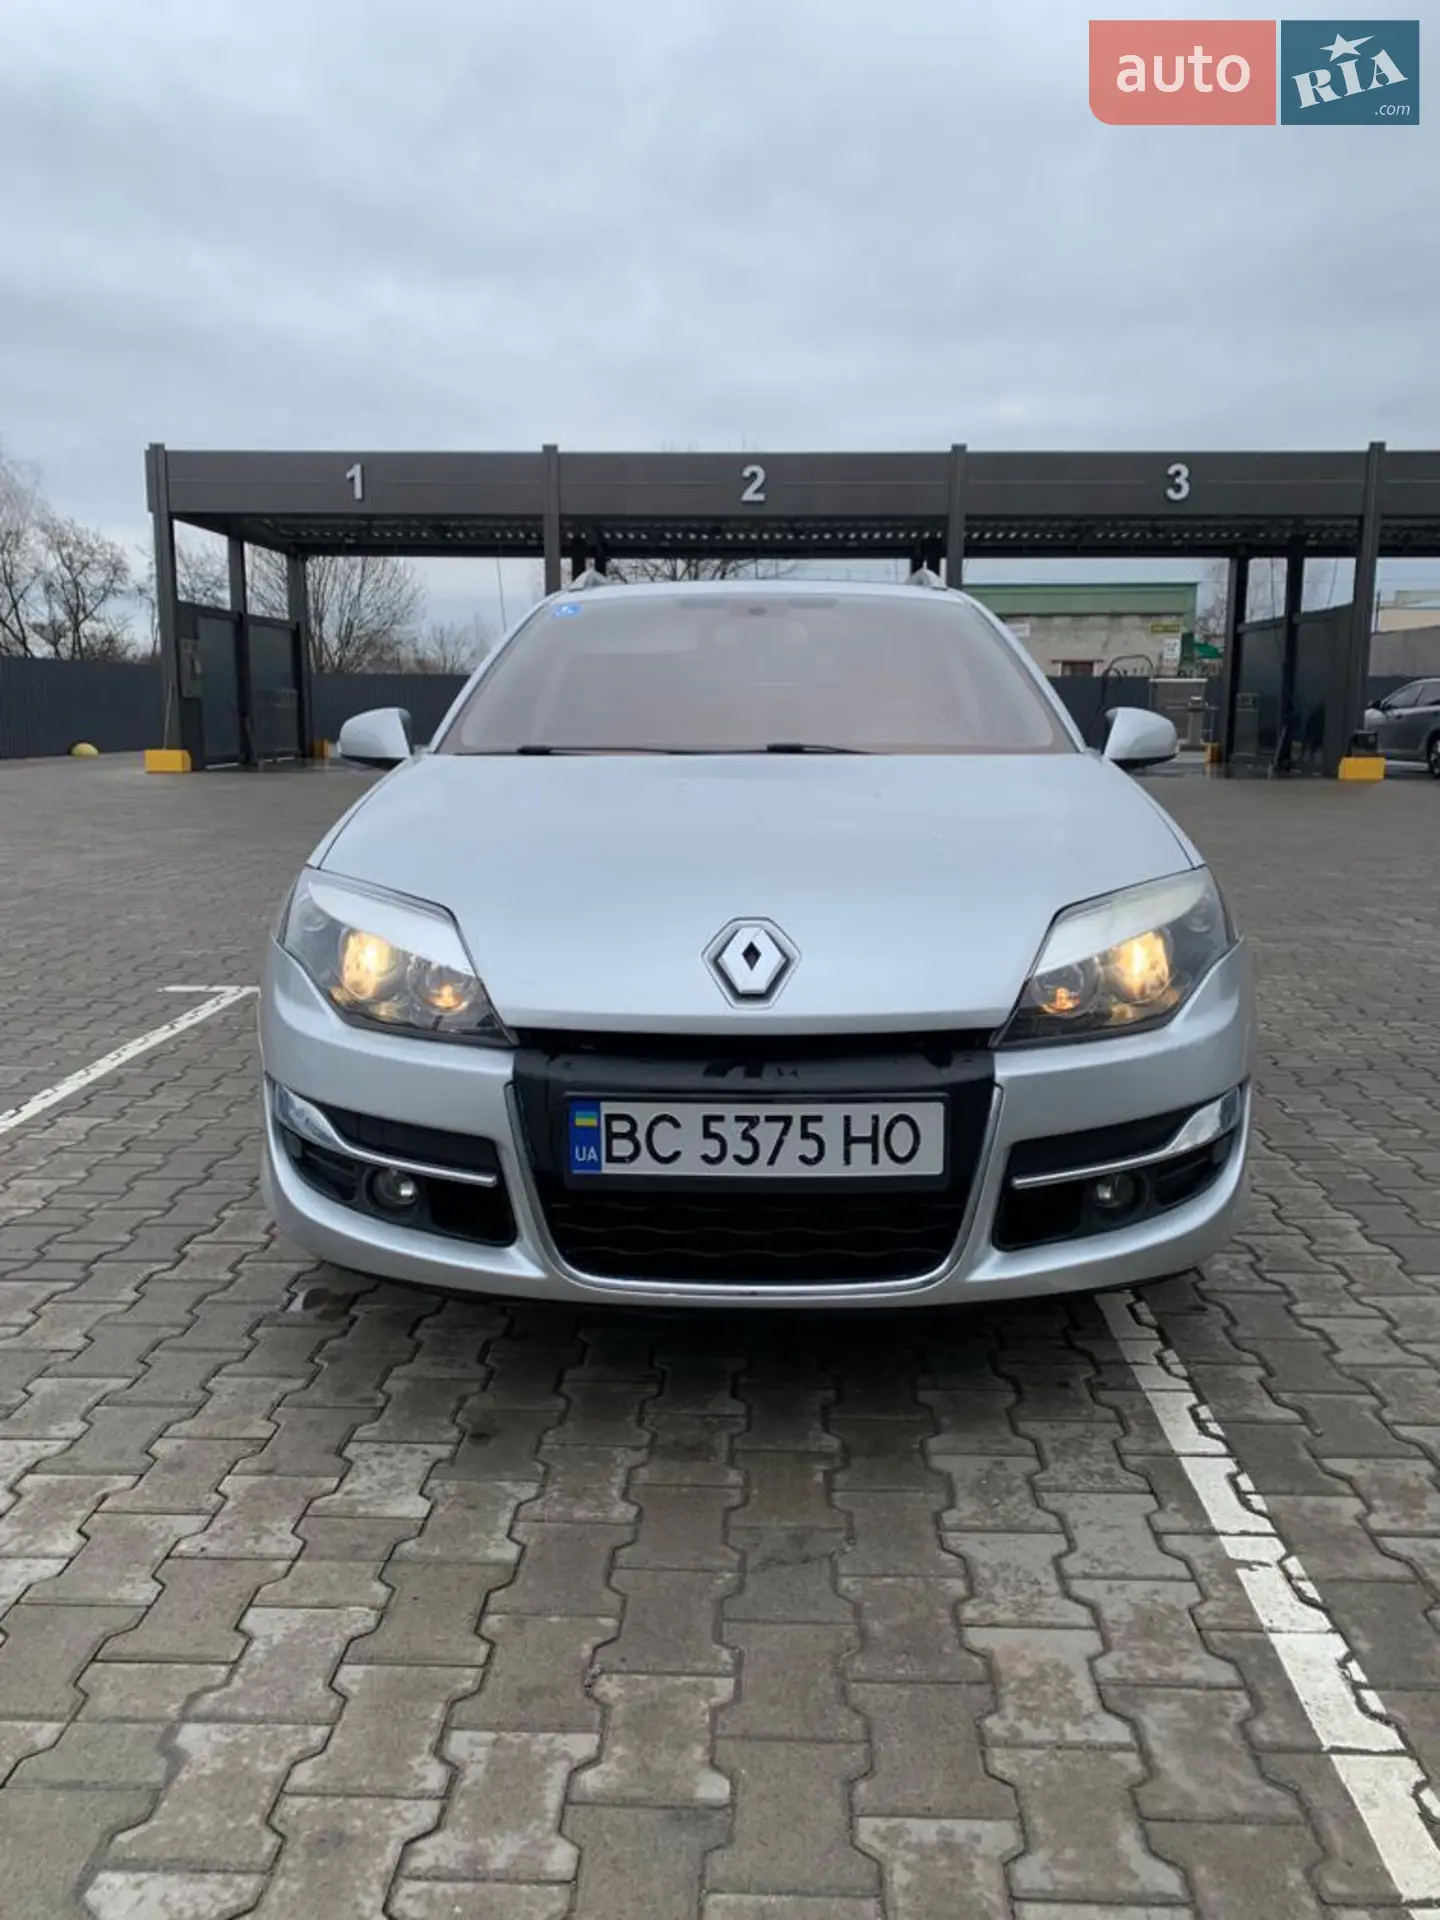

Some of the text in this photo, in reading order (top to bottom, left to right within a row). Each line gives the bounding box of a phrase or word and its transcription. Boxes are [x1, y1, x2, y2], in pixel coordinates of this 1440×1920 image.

[346, 463, 363, 500] 1
[741, 465, 766, 501] 2
[1166, 463, 1190, 501] 3
[574, 1144, 599, 1162] UA
[603, 1113, 922, 1167] BC 5375 HO
